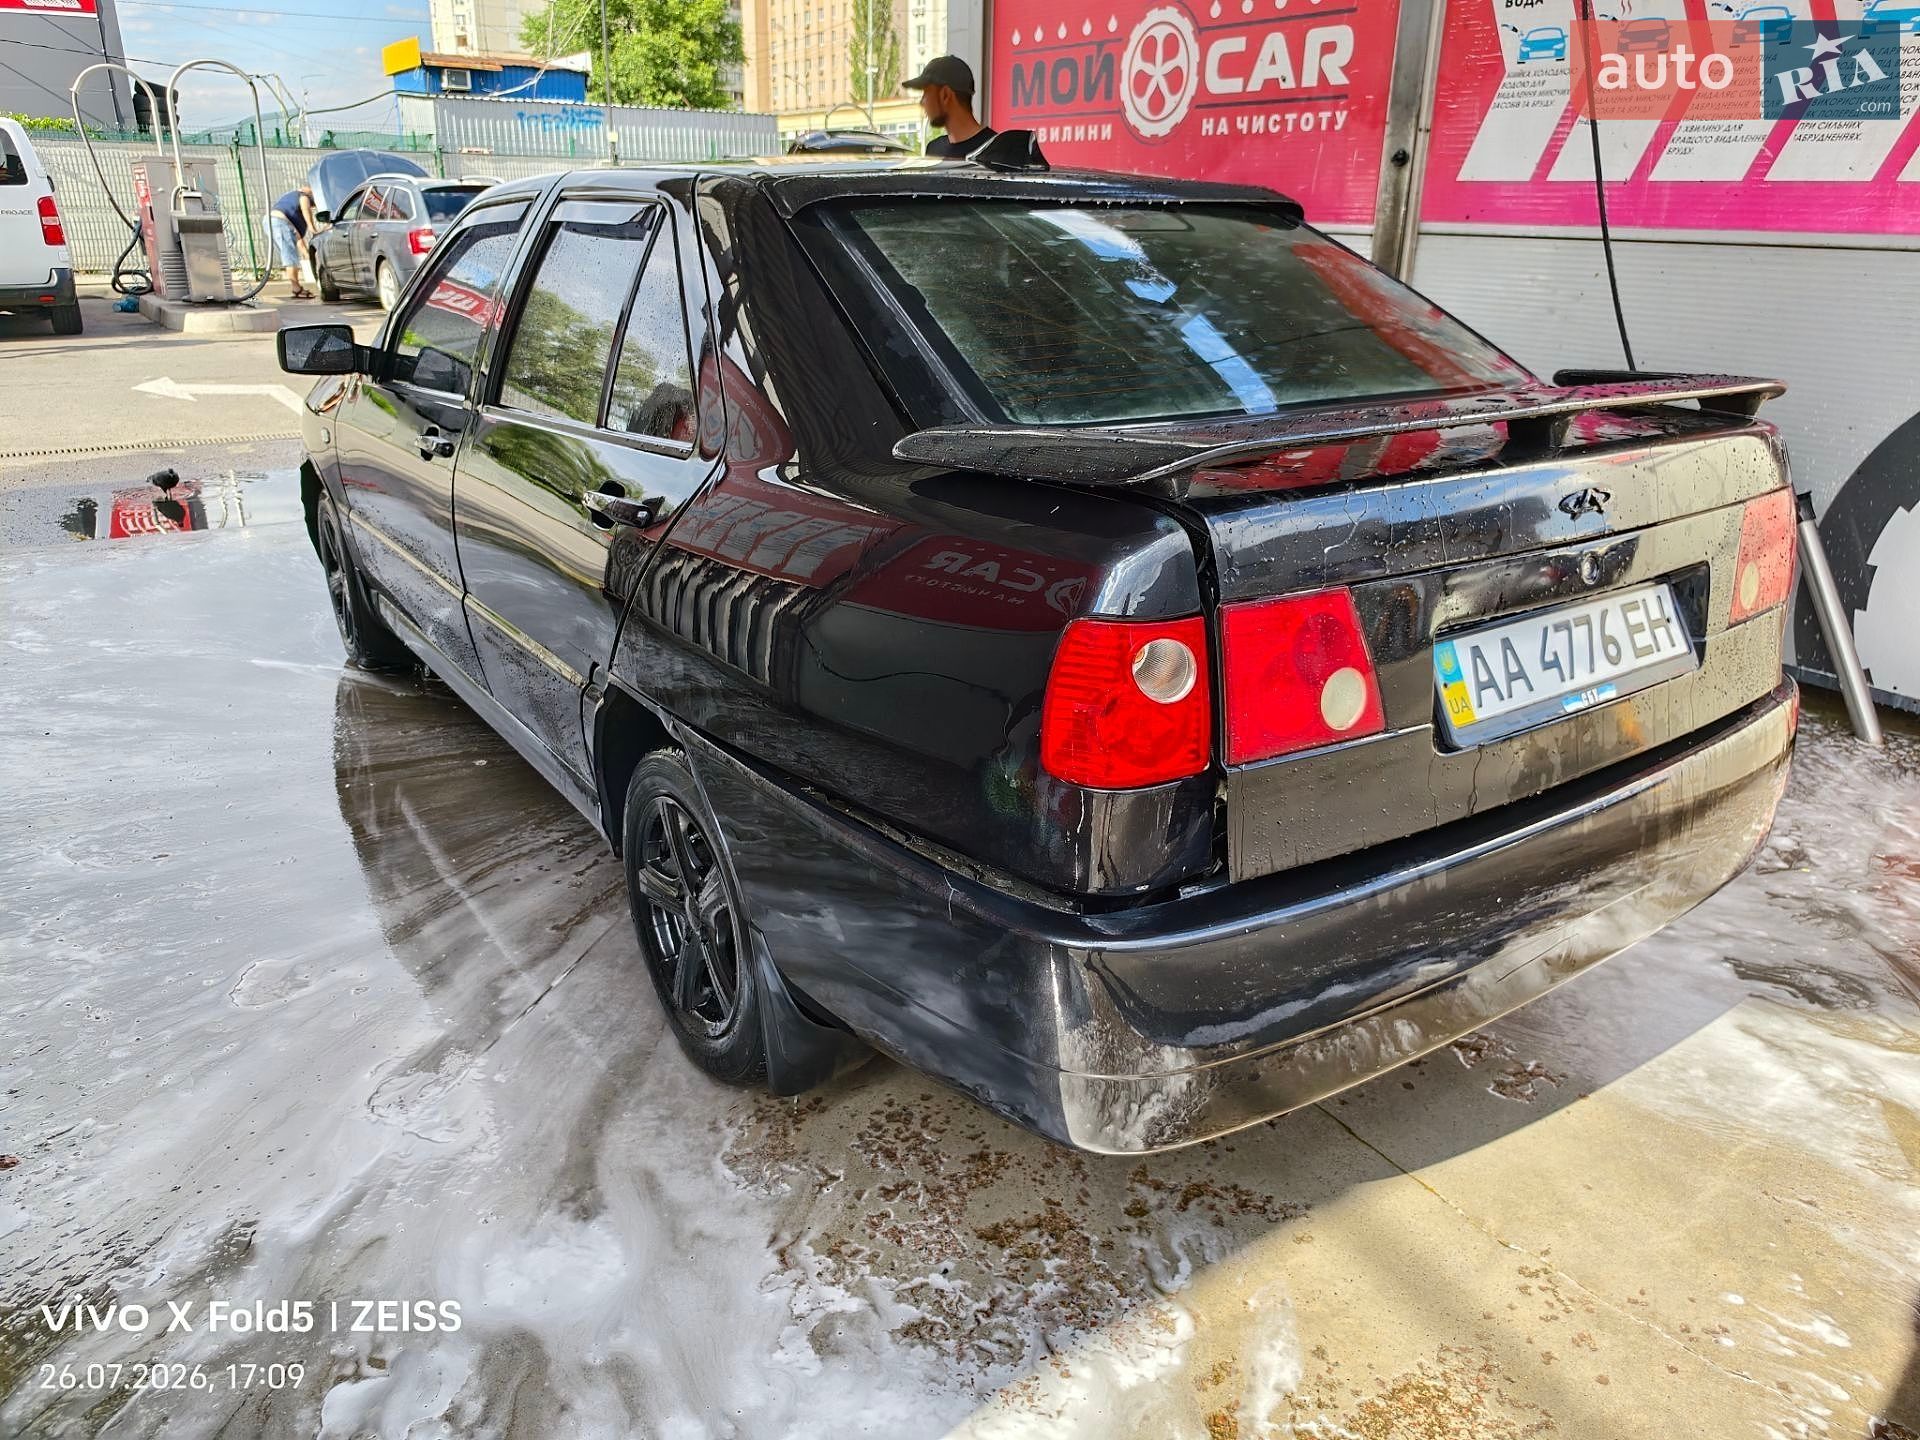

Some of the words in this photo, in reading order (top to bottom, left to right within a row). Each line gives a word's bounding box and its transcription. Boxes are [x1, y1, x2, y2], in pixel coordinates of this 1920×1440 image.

[1012, 42, 1115, 107] МОЙ
[1205, 25, 1354, 94] CAR
[1027, 123, 1113, 143] ВИЛИНИ
[1201, 117, 1229, 136] НА
[1236, 110, 1348, 135] ЧИСТОТУ
[1539, 608, 1622, 684] 4776
[1448, 698, 1473, 715] UA
